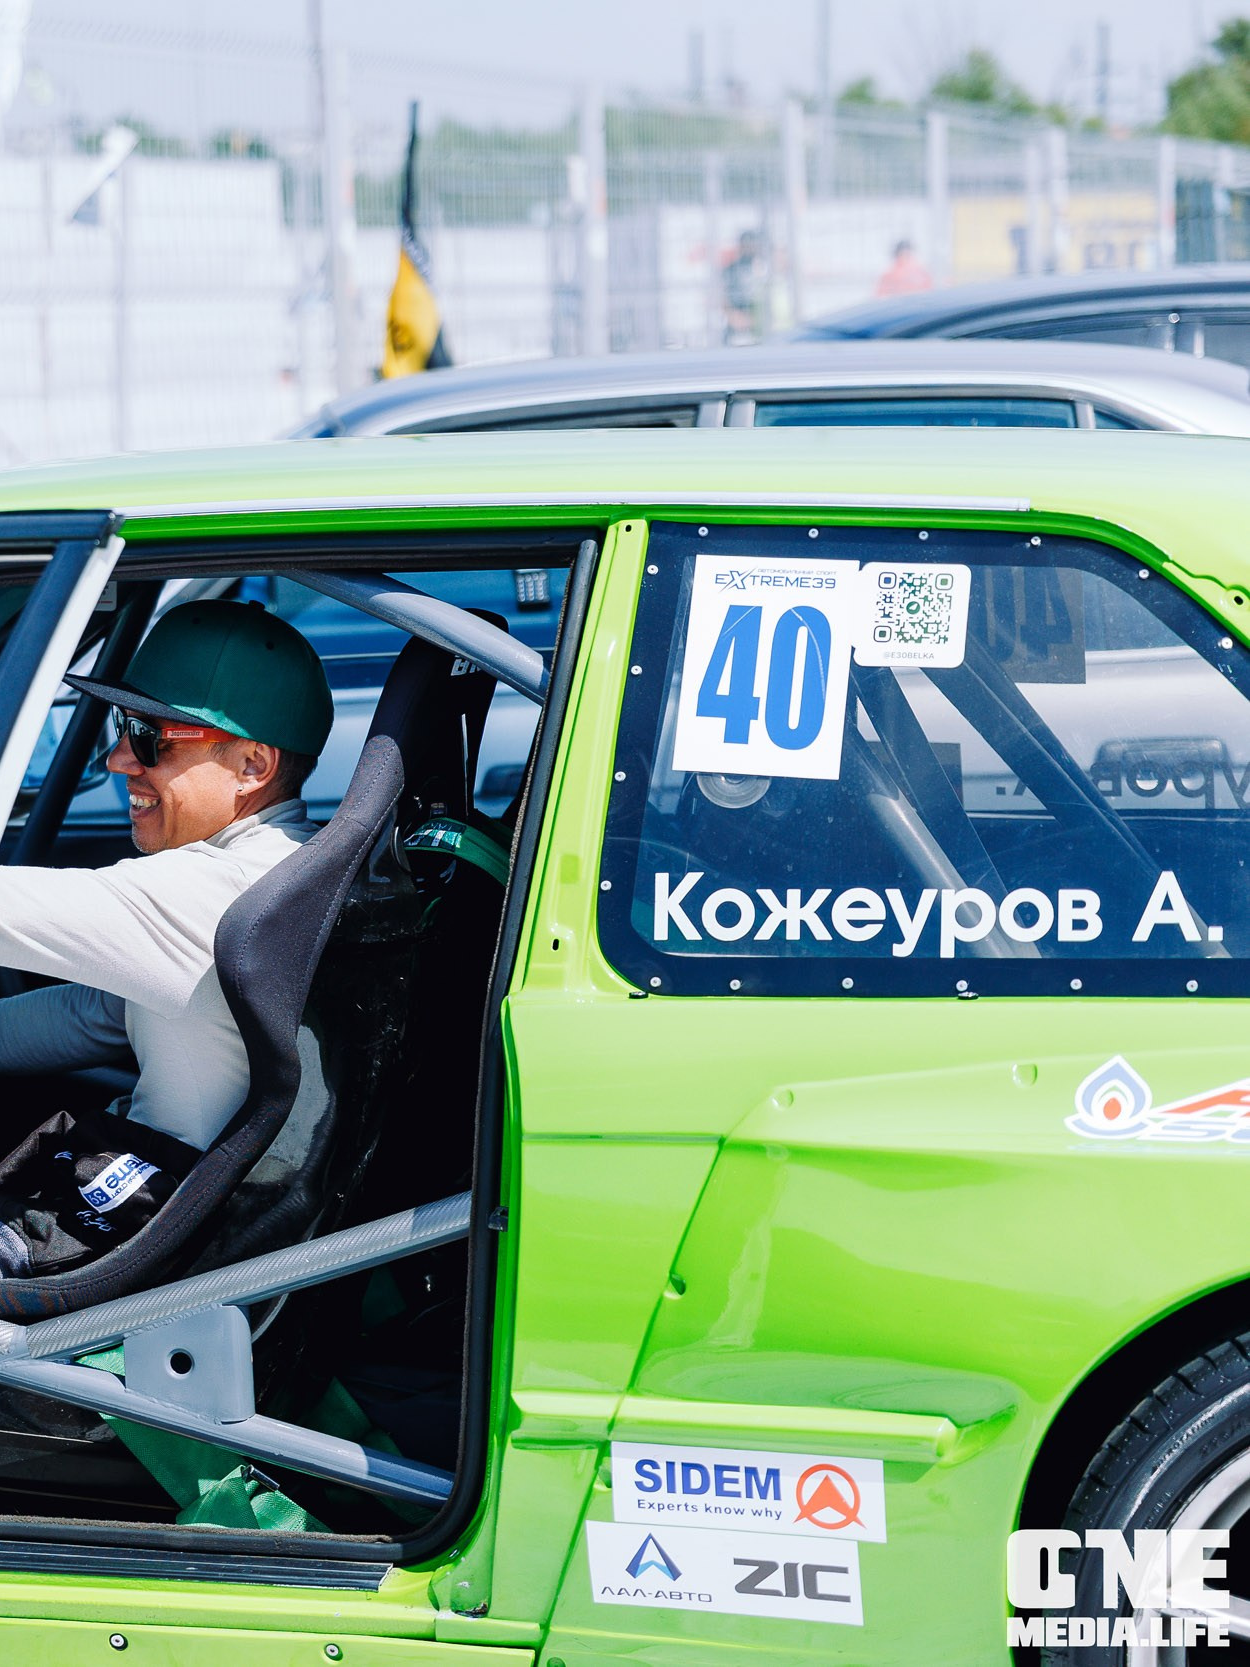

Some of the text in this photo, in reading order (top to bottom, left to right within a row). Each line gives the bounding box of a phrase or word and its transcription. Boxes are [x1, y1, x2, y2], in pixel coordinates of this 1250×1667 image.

[714, 567, 837, 593] EXTREME39
[695, 604, 832, 750] 40
[653, 870, 1223, 958] Кожеуров А.
[634, 1459, 782, 1501] SIDEM
[637, 1499, 783, 1520] Experts know why
[733, 1557, 851, 1603] ZIC
